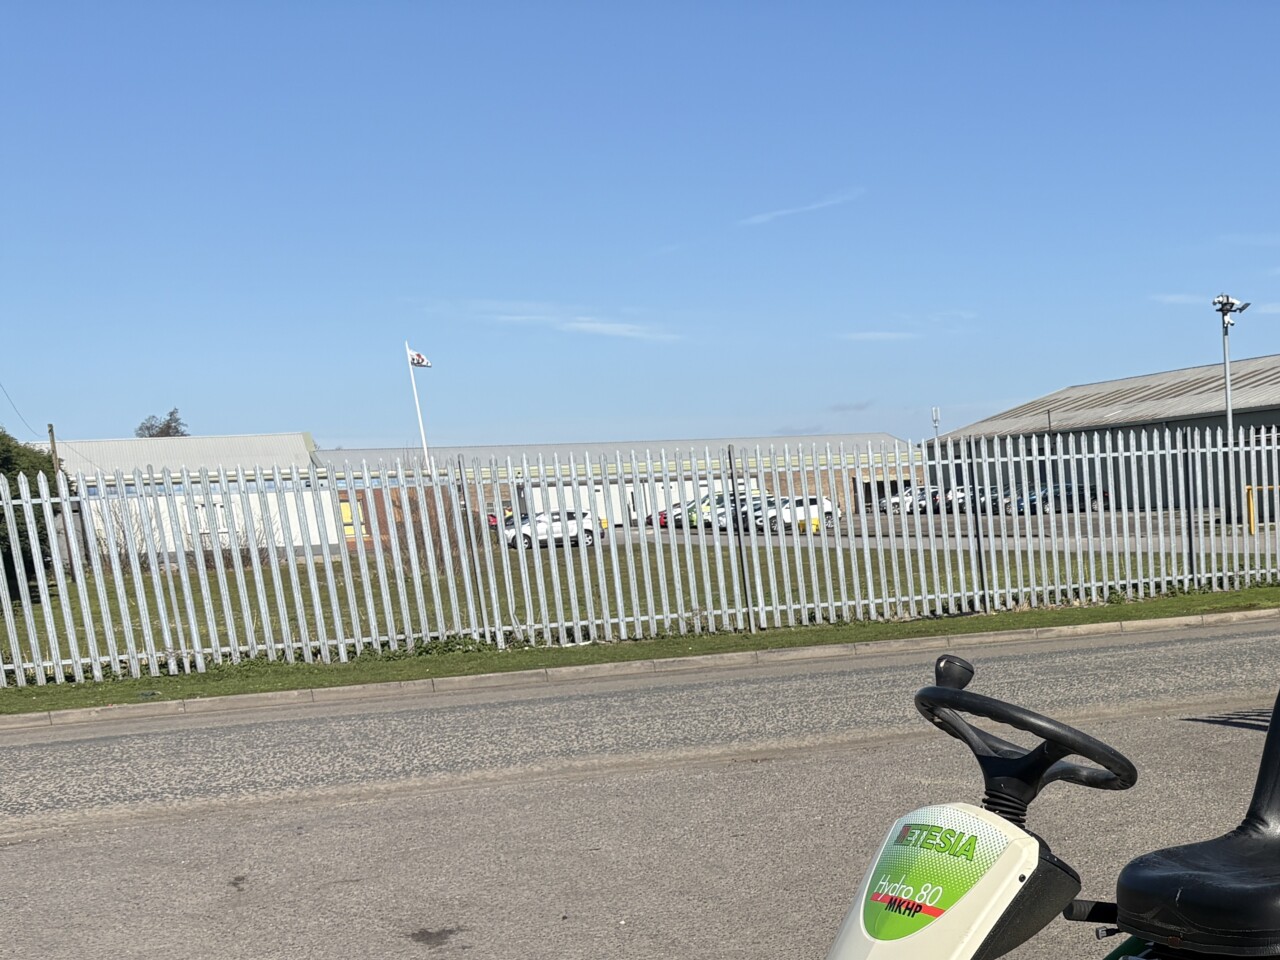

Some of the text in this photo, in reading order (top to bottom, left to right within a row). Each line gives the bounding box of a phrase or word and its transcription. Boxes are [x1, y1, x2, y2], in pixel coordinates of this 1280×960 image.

[896, 823, 978, 862] ETESIA
[874, 874, 943, 907] Hydro 80
[884, 897, 923, 918] MKHP
